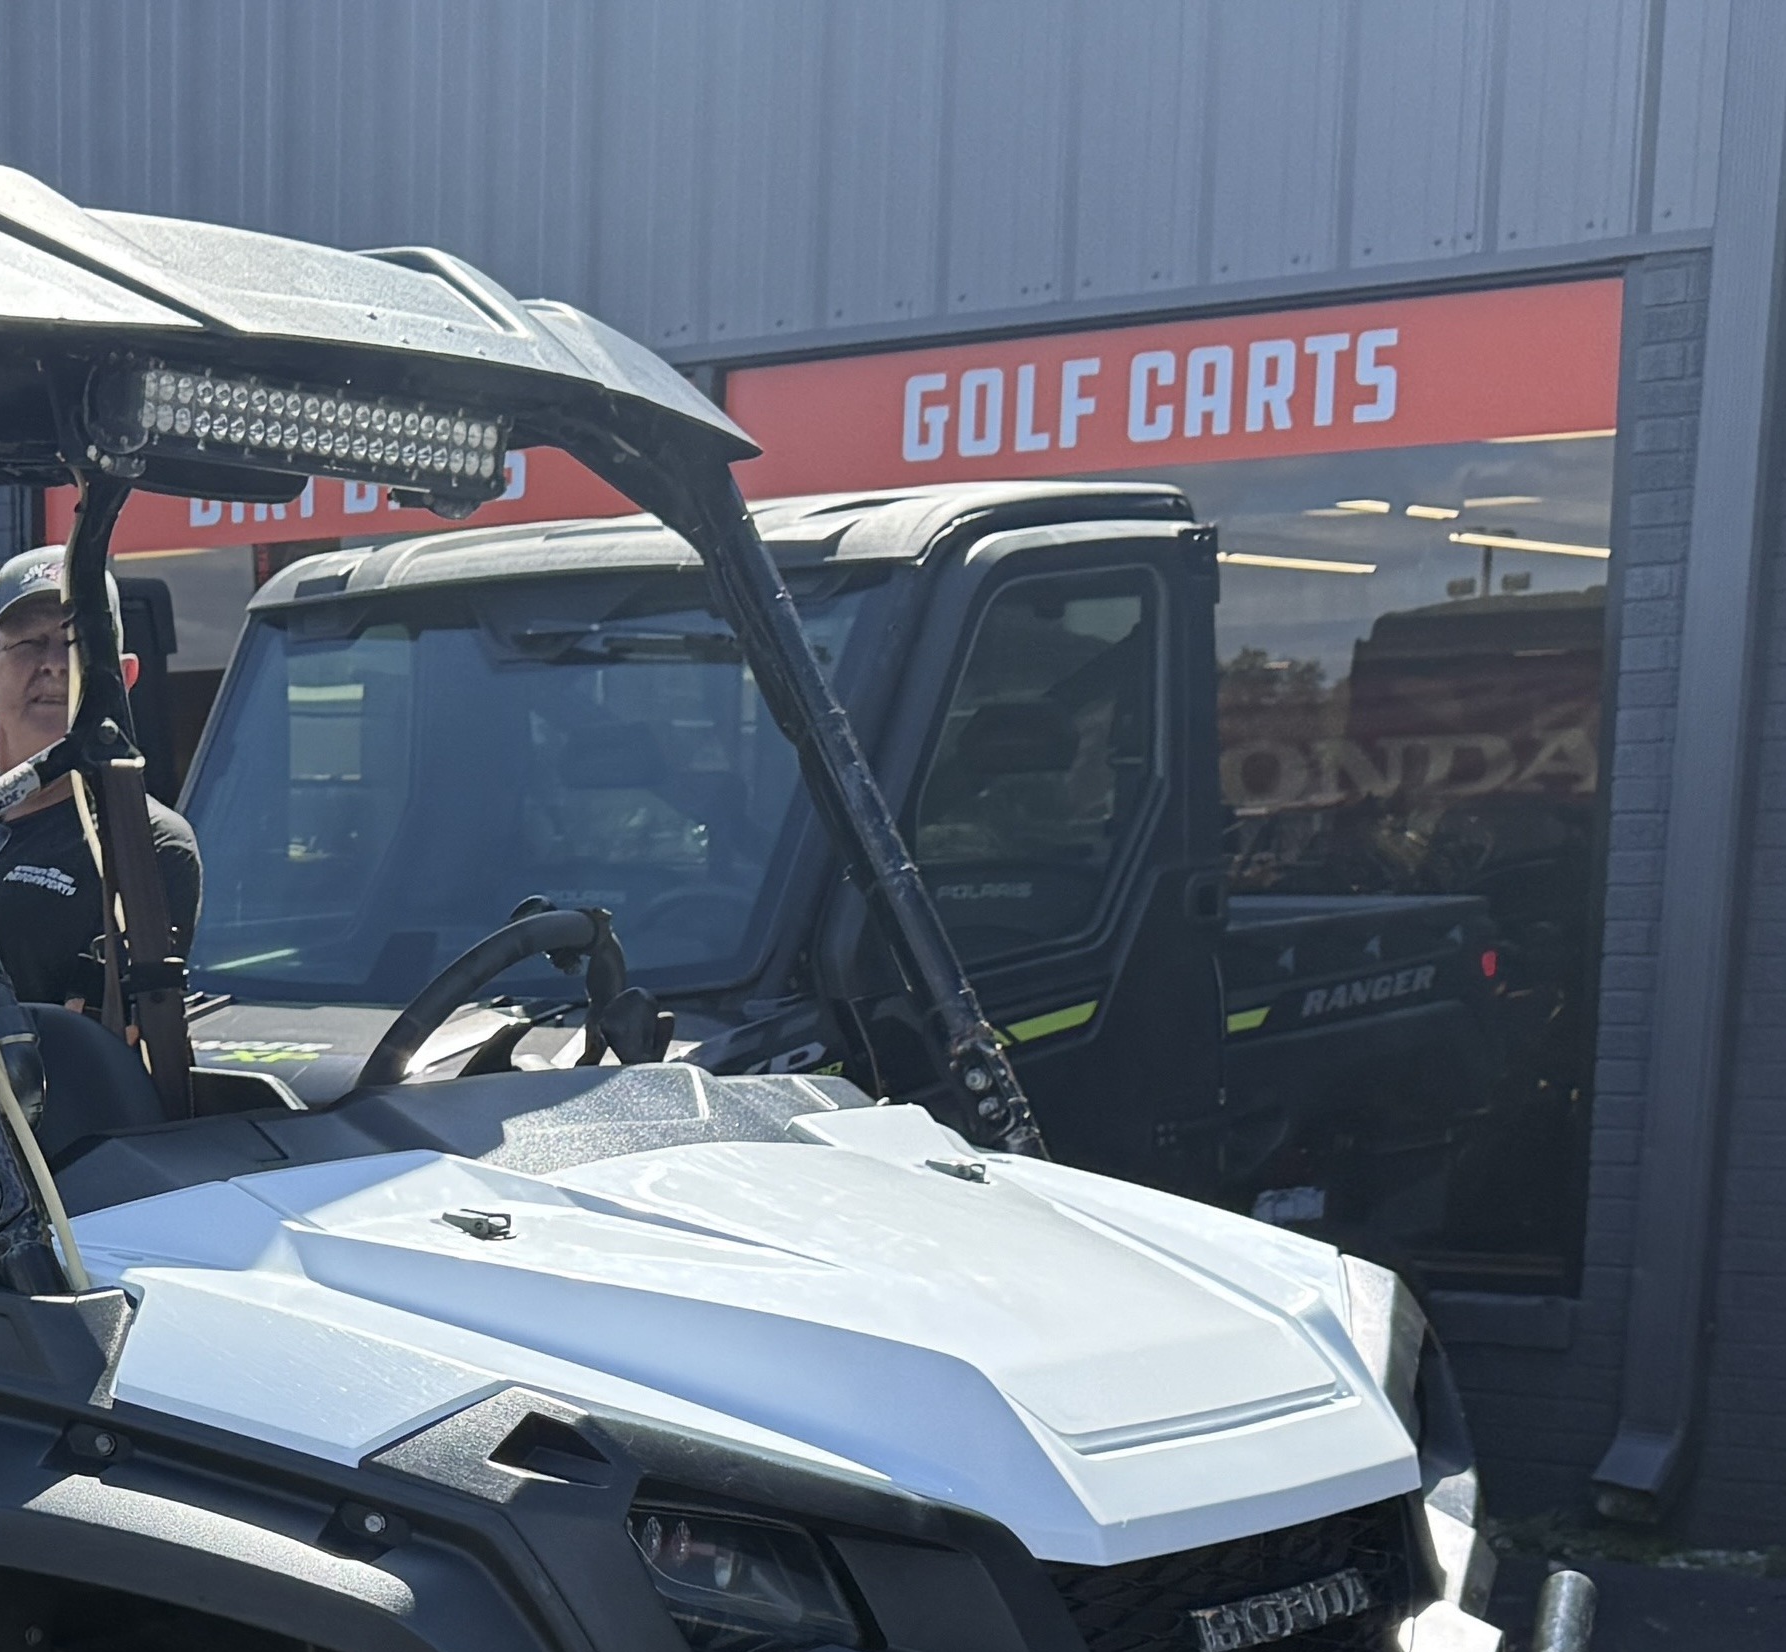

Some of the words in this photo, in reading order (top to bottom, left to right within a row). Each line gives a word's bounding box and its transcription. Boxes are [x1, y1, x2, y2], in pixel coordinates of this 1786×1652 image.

[902, 357, 1100, 463] GOLF
[1127, 328, 1399, 442] CARTS
[1219, 727, 1600, 803] ONDA
[1301, 964, 1436, 1019] RANGER
